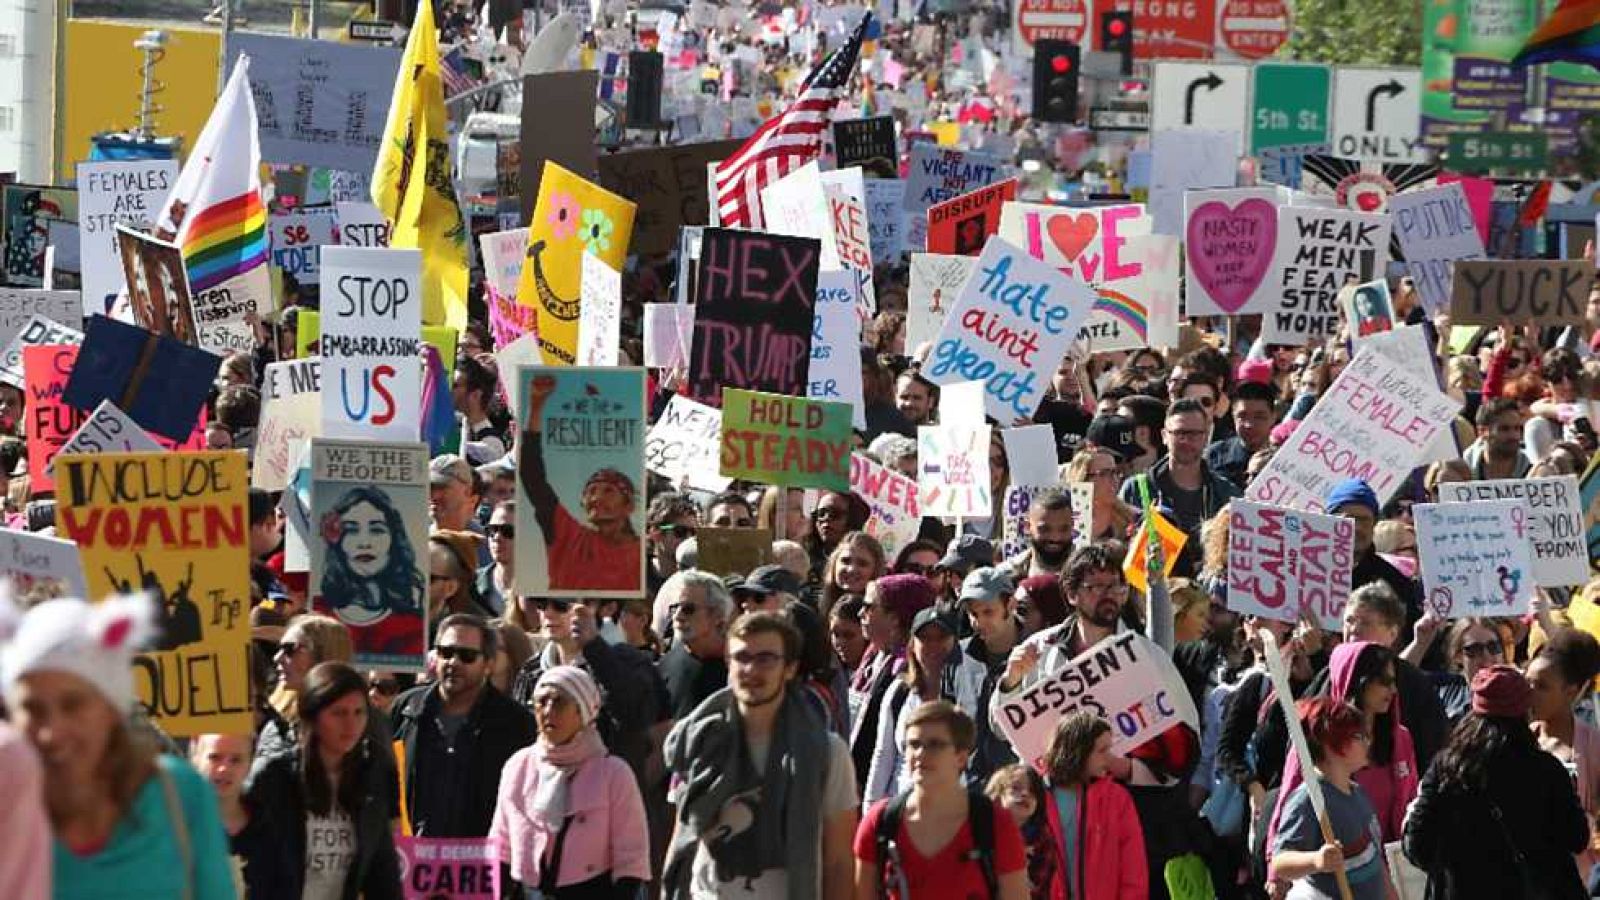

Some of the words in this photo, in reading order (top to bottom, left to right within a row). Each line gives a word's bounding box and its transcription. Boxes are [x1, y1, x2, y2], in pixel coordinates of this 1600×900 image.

[1257, 108, 1289, 130] 5th
[1339, 134, 1415, 157] ONLY
[1463, 138, 1502, 158] 5th
[88, 170, 168, 192] FEMALES
[922, 158, 997, 183] VIGILANT
[113, 193, 146, 213] ARE
[932, 186, 1006, 225] DISRUPT
[1204, 217, 1258, 238] NASTY
[1296, 216, 1380, 247] WEAK
[704, 236, 815, 307] HEX
[1294, 245, 1356, 269] MEN
[338, 275, 409, 320] STOP
[979, 254, 1070, 335] hate
[1460, 267, 1583, 317] YUCK
[322, 334, 419, 358] EMBARRASSING
[693, 318, 809, 390] TRUMP
[962, 308, 1039, 369] ain't
[341, 364, 397, 427] US
[931, 338, 1037, 415] great
[750, 398, 824, 430] HOLD
[1331, 375, 1437, 448] FEMALE!
[546, 417, 640, 447] RESILIENT
[326, 447, 364, 466] WE
[368, 449, 412, 467] THE
[326, 463, 415, 483] PEOPLE
[722, 428, 851, 480] STEADY
[63, 456, 232, 507] INCLUDE
[60, 503, 247, 550] WOMEN
[1544, 513, 1581, 539] YOU
[1231, 511, 1255, 593] KEEP
[1253, 509, 1287, 608] CALM
[1299, 520, 1330, 617] STAY
[1329, 520, 1353, 617] STRONG
[208, 588, 242, 630] The
[1002, 634, 1138, 731] DISSENT
[312, 827, 352, 849] FOR
[413, 863, 494, 893] CARE
